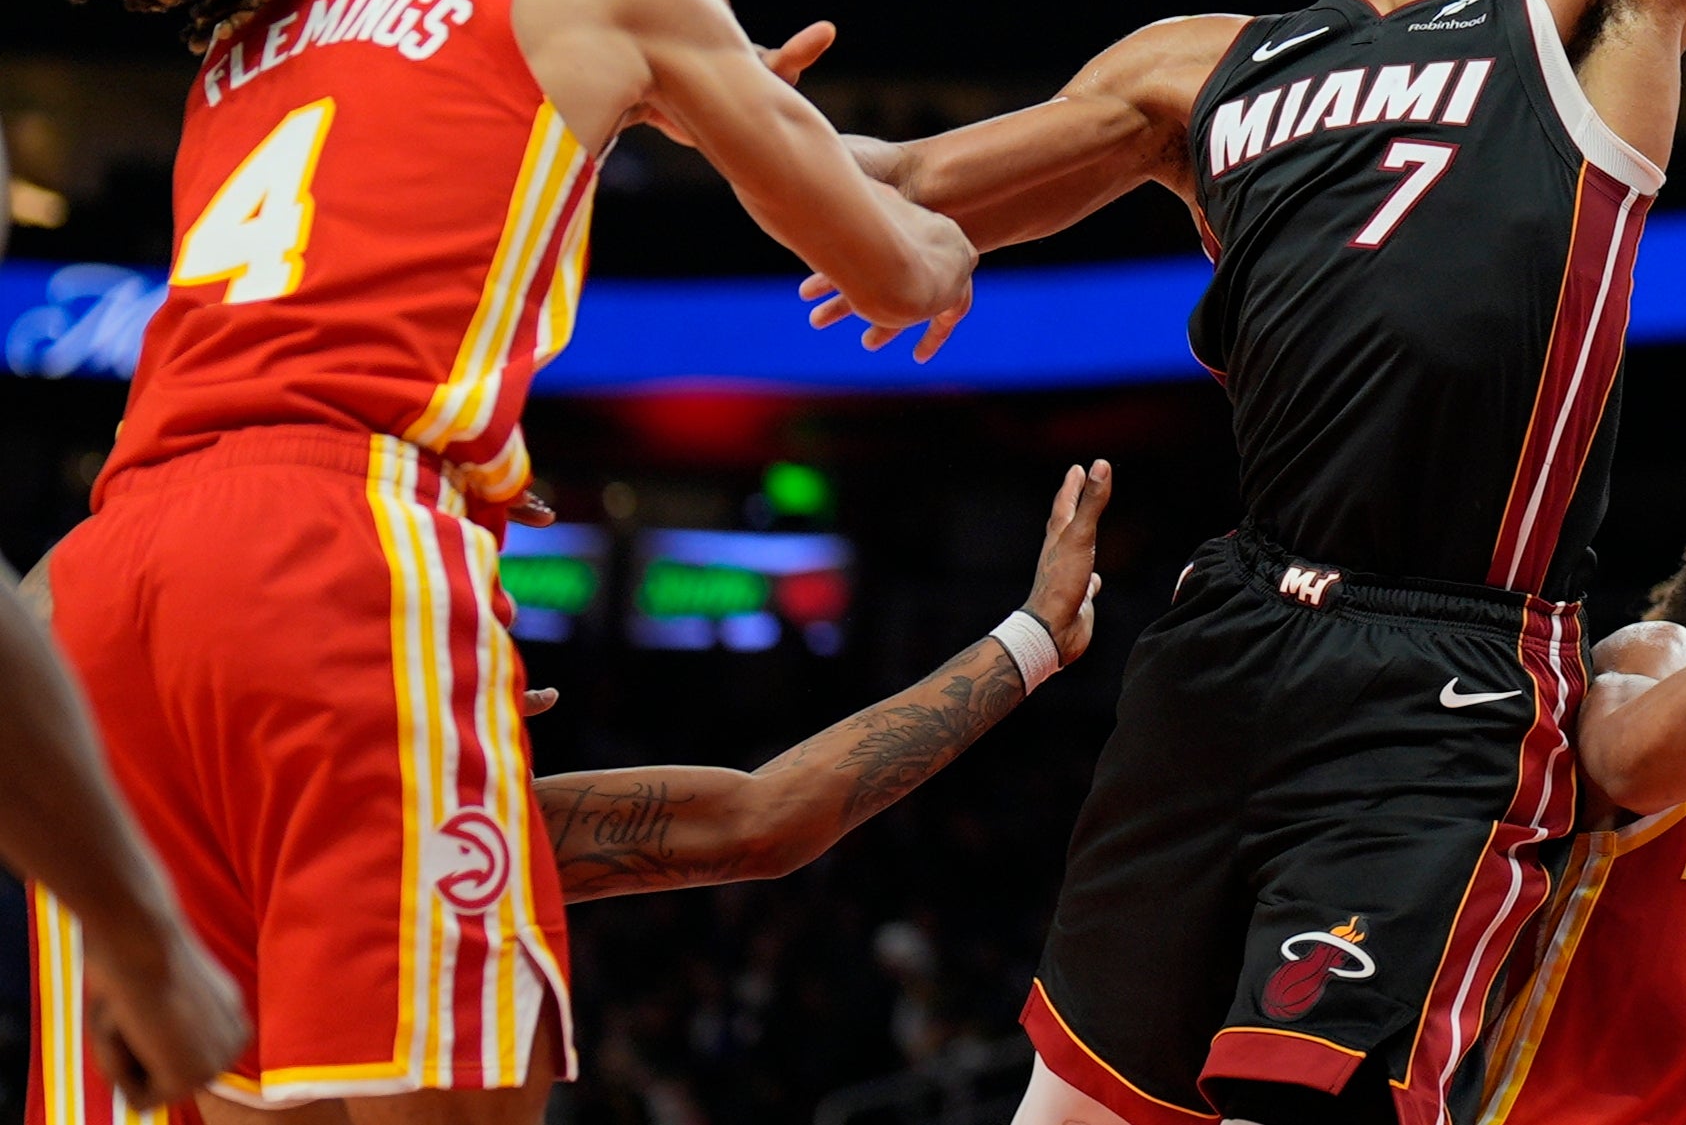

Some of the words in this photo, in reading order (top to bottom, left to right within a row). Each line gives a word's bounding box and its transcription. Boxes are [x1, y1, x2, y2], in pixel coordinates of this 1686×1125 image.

[1407, 12, 1488, 33] Robinhood
[1209, 57, 1497, 181] MIAMI
[169, 95, 336, 305] 4
[1347, 136, 1462, 251] 7
